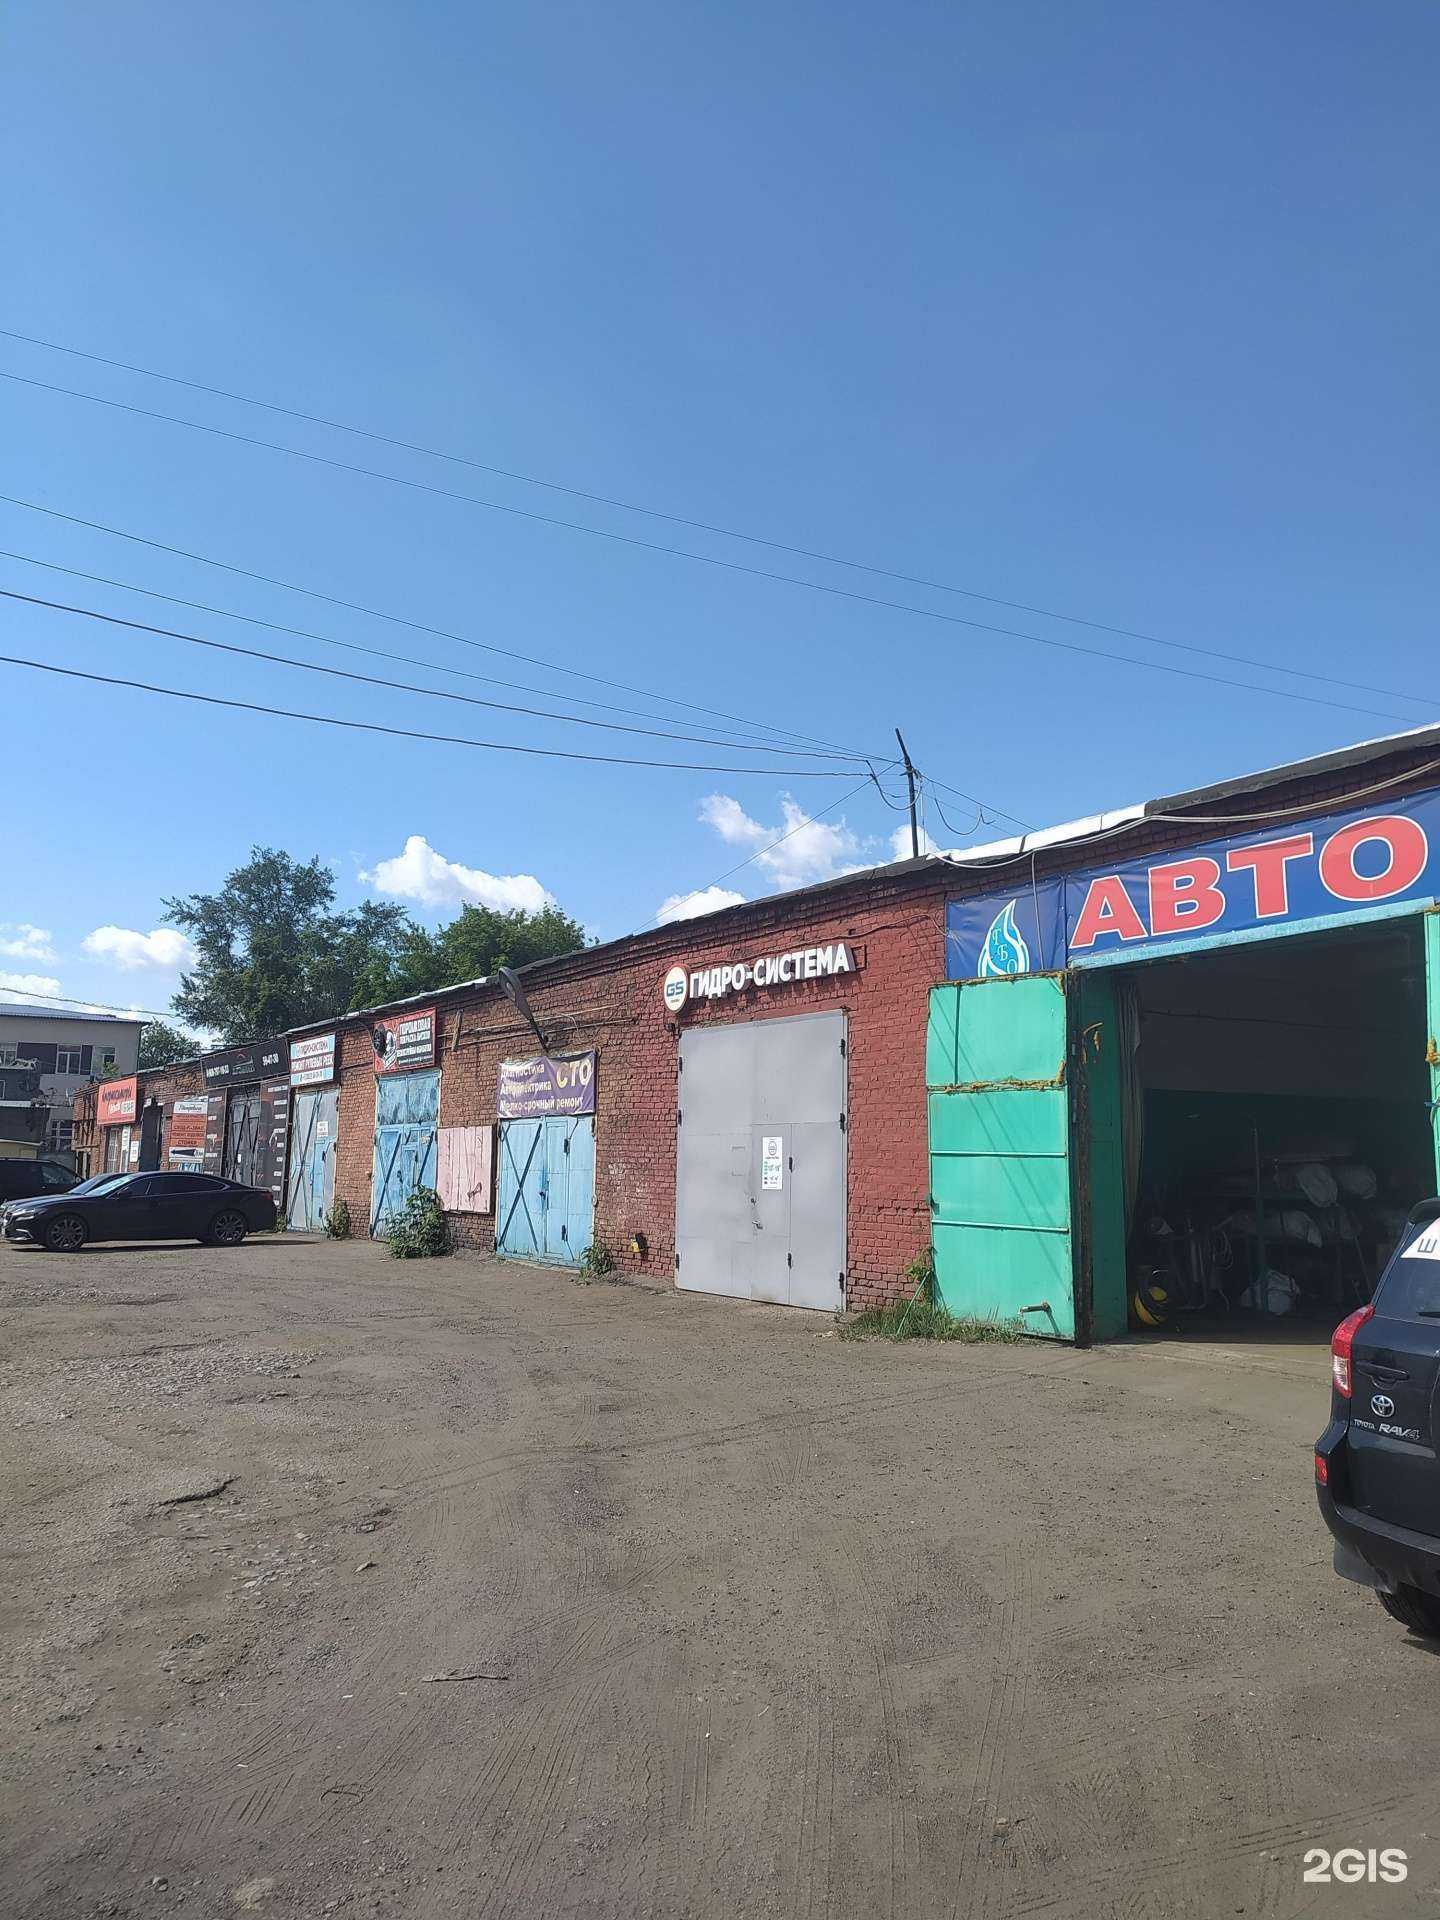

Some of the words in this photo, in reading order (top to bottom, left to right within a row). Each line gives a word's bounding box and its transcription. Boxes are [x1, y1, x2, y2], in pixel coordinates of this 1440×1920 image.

[1069, 814, 1429, 950] АВТО
[689, 943, 852, 999] ГИДРО-СИСТЕМА
[666, 983, 685, 997] GS
[556, 1059, 592, 1088] СТО
[1354, 1418, 1375, 1431] TOYOTA
[1378, 1423, 1421, 1440] RAV4
